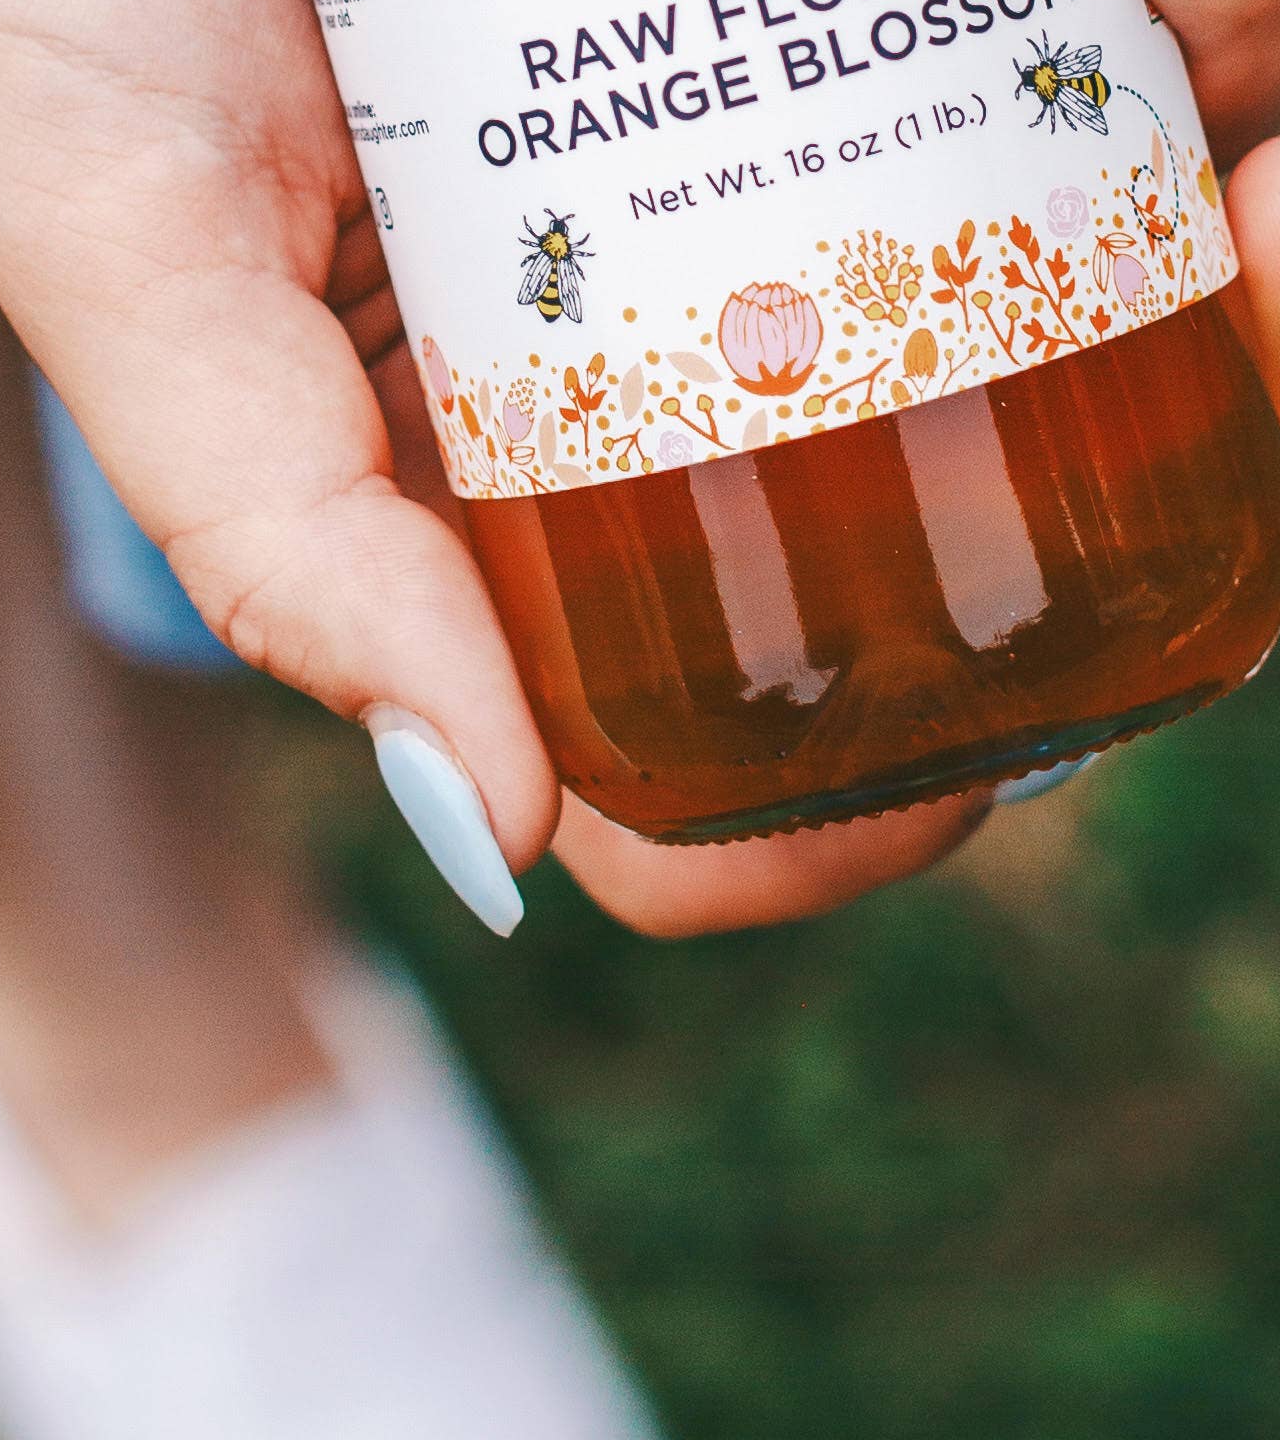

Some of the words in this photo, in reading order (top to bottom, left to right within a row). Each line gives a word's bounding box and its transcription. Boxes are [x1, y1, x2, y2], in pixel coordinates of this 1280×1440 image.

[520, 4, 677, 90] RAW
[478, 55, 759, 168] ORANGE
[629, 179, 697, 221] Net
[705, 161, 776, 201] Wt.
[783, 143, 826, 181] 16
[838, 131, 884, 163] oz
[893, 113, 925, 153] (1
[935, 92, 989, 135] lb.)
